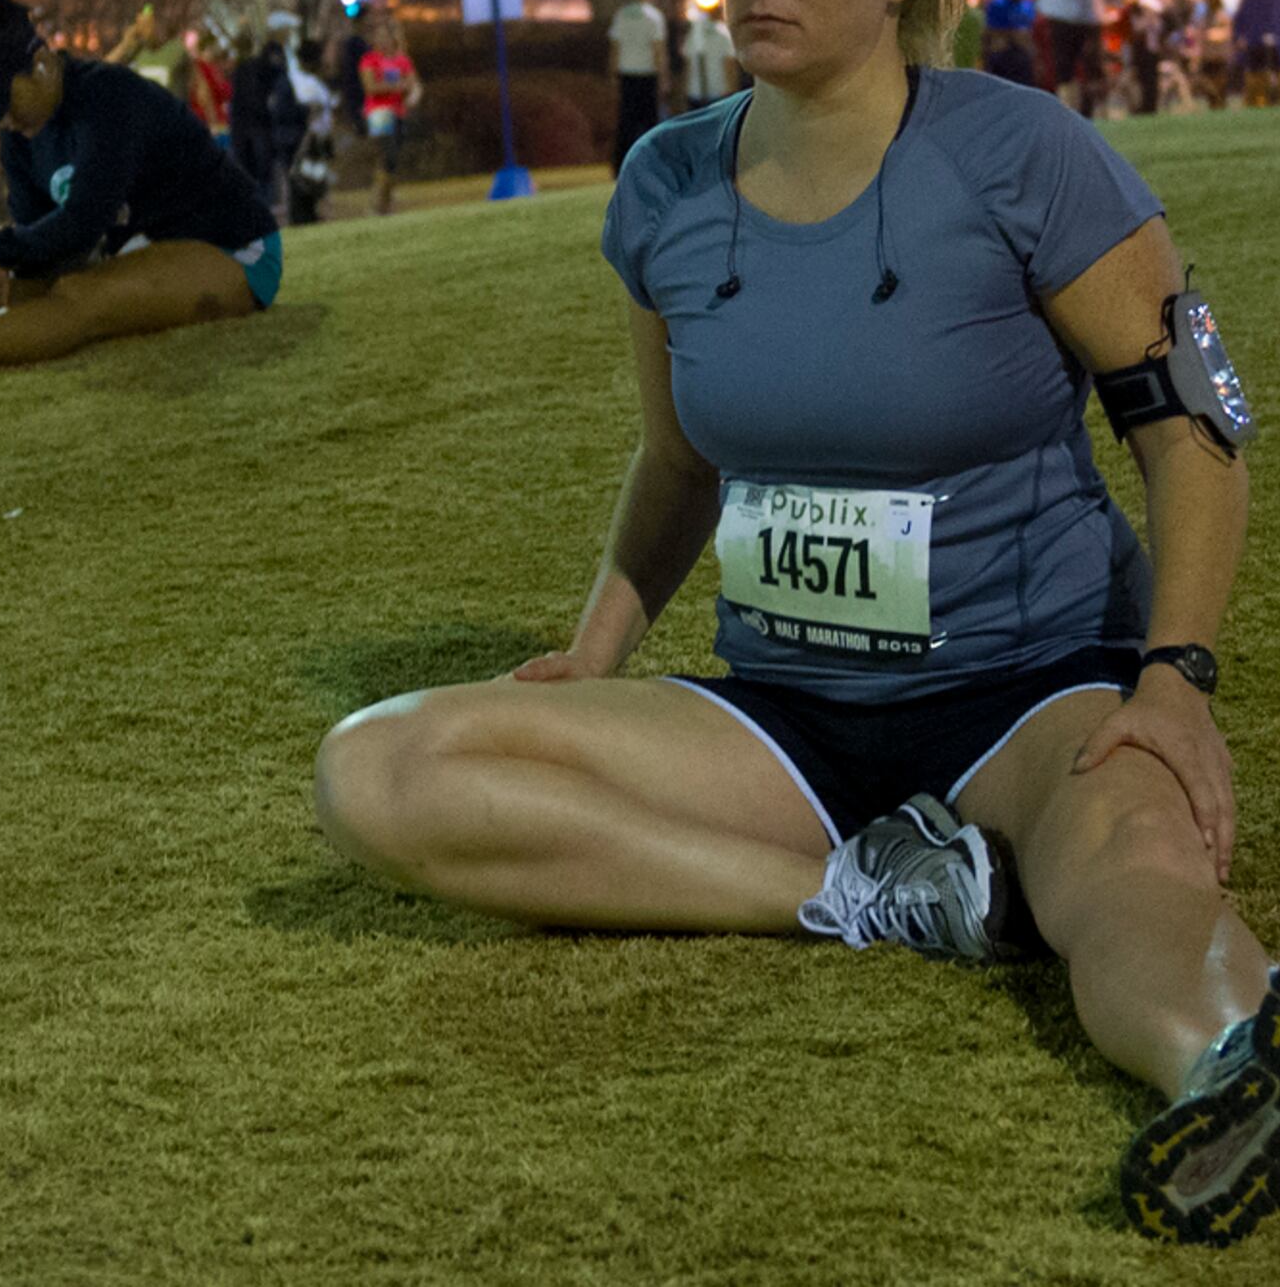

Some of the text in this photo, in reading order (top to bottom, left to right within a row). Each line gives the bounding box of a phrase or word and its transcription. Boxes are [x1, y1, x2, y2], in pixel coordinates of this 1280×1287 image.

[900, 521, 912, 536] J
[758, 527, 877, 601] 14571
[774, 620, 800, 640] HALF
[807, 626, 871, 652] MARATHON
[878, 640, 921, 654] 2013
